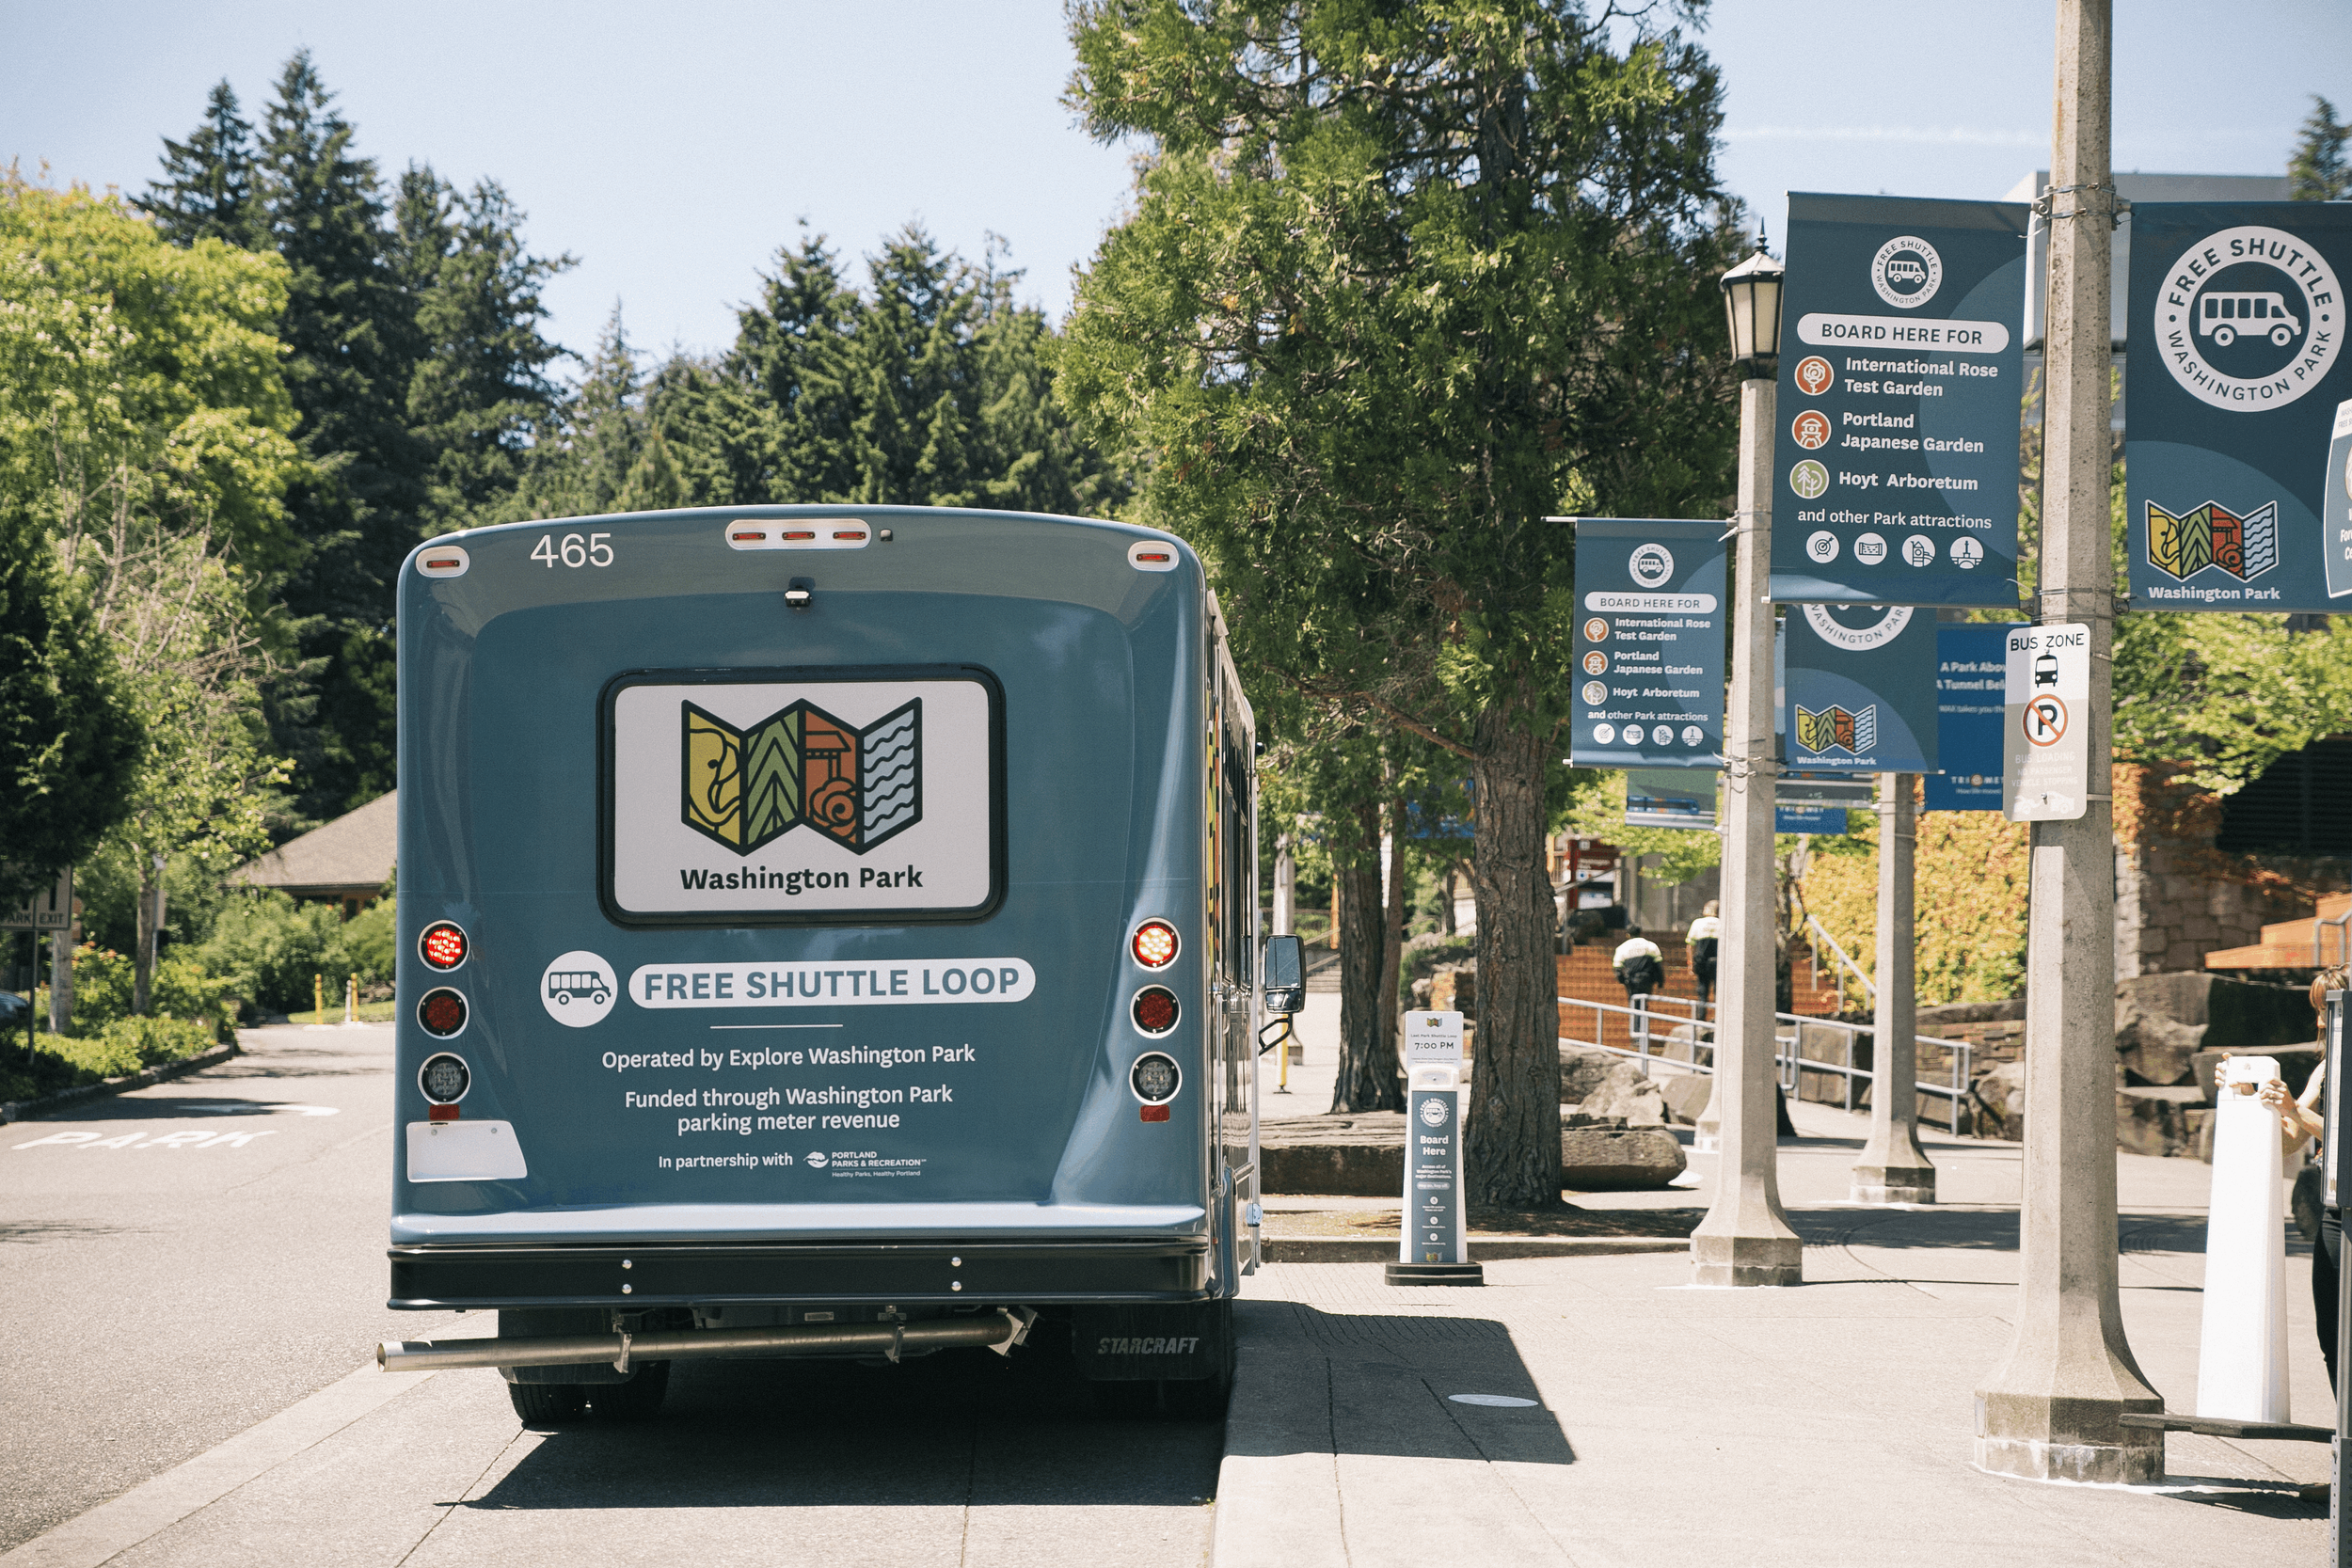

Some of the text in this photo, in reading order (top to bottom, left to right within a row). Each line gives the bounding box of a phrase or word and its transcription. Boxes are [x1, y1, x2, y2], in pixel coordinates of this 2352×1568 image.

[1877, 240, 1938, 269] FREE SHUTTLE
[2169, 237, 2333, 307] FREE SHUTTLE
[1877, 275, 1936, 304] WASHINGTON PARK
[1821, 323, 1983, 344] BOARD HERE FOR
[1846, 357, 1998, 377] International Rose
[2168, 329, 2331, 401] WASHINGTON PARK
[1844, 379, 1943, 397] Test Garden
[1842, 412, 1914, 429] Portland
[1840, 434, 1983, 453] Japanese Garden
[1839, 472, 1979, 491] Hoyt Arboretum
[1798, 509, 1993, 529] and other Park attractions
[531, 532, 613, 568] 465
[1633, 546, 1671, 562] FREE SHUTTLE
[2148, 586, 2280, 602] Washington Park
[1601, 598, 1700, 609] BOARD HERE FOR
[1615, 618, 1710, 628] International Rose
[1885, 609, 1904, 630] PAR
[1614, 631, 1677, 641] Test Garden
[2010, 633, 2085, 651] BUS ZONE
[1614, 651, 1660, 660] Portland
[1613, 664, 1703, 675] Japanese Garden
[1940, 662, 1949, 673] A
[1951, 660, 1979, 673] Park
[1613, 688, 1699, 698] Hoyt Arboretum
[1944, 679, 1984, 690] Tunnel
[1985, 679, 2006, 690] Bel
[1588, 710, 1708, 721] and other Park attractions
[1797, 756, 1876, 766] Washington Park
[2015, 752, 2075, 764] BUS LOADING
[679, 864, 924, 895] Washington Park
[40, 912, 64, 924] EXIT
[644, 967, 1020, 1000] FREE SHUTTLE LOOP
[602, 1044, 976, 1072] Operated by Explore Washington Park
[625, 1084, 953, 1110] Funded through Washington Park
[677, 1114, 900, 1136] parking meter revenue
[11, 1131, 278, 1149] PARK
[1420, 1134, 1449, 1144] Board
[659, 1152, 792, 1170] In partnership with
[1097, 1338, 1200, 1354] STARCRAFT
